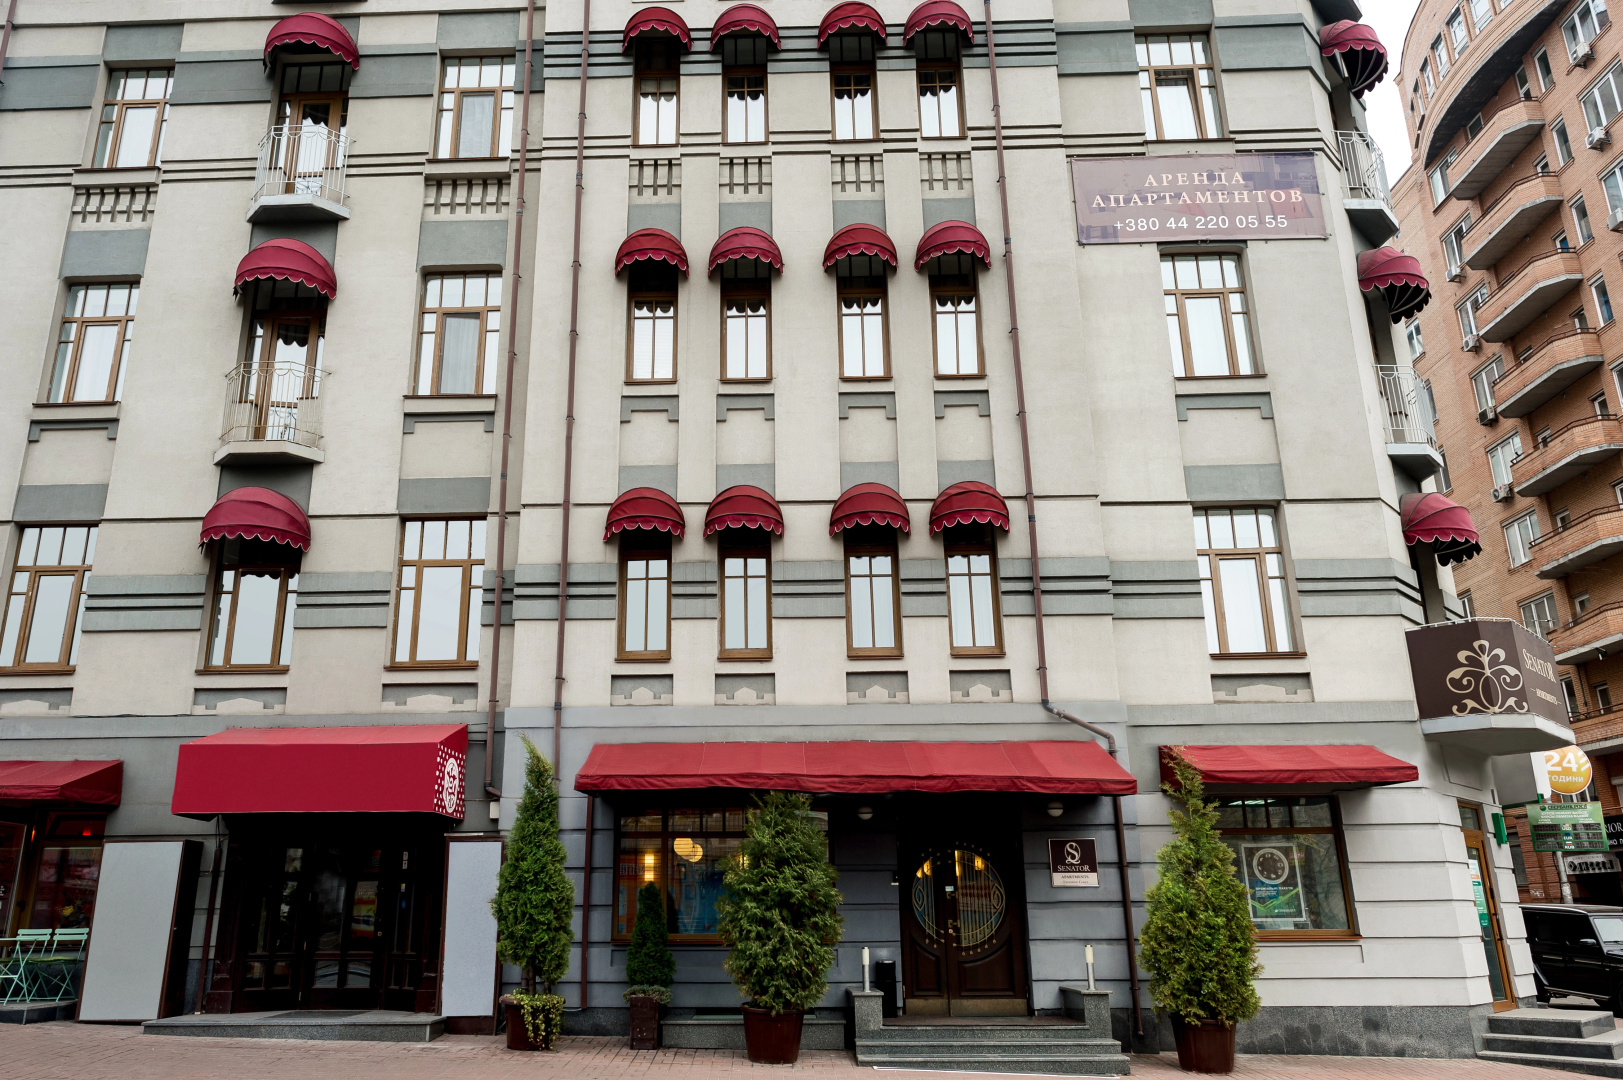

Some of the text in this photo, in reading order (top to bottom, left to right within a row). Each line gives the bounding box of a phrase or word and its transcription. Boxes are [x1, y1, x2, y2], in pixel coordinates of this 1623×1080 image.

[1144, 171, 1246, 187] АРЕНДА
[1091, 189, 1304, 208] АПАРТАМЕНТОВ
[1113, 214, 1288, 232] +380 44 220 05 55
[1522, 648, 1557, 683] SENATOR
[1543, 751, 1578, 772] 24
